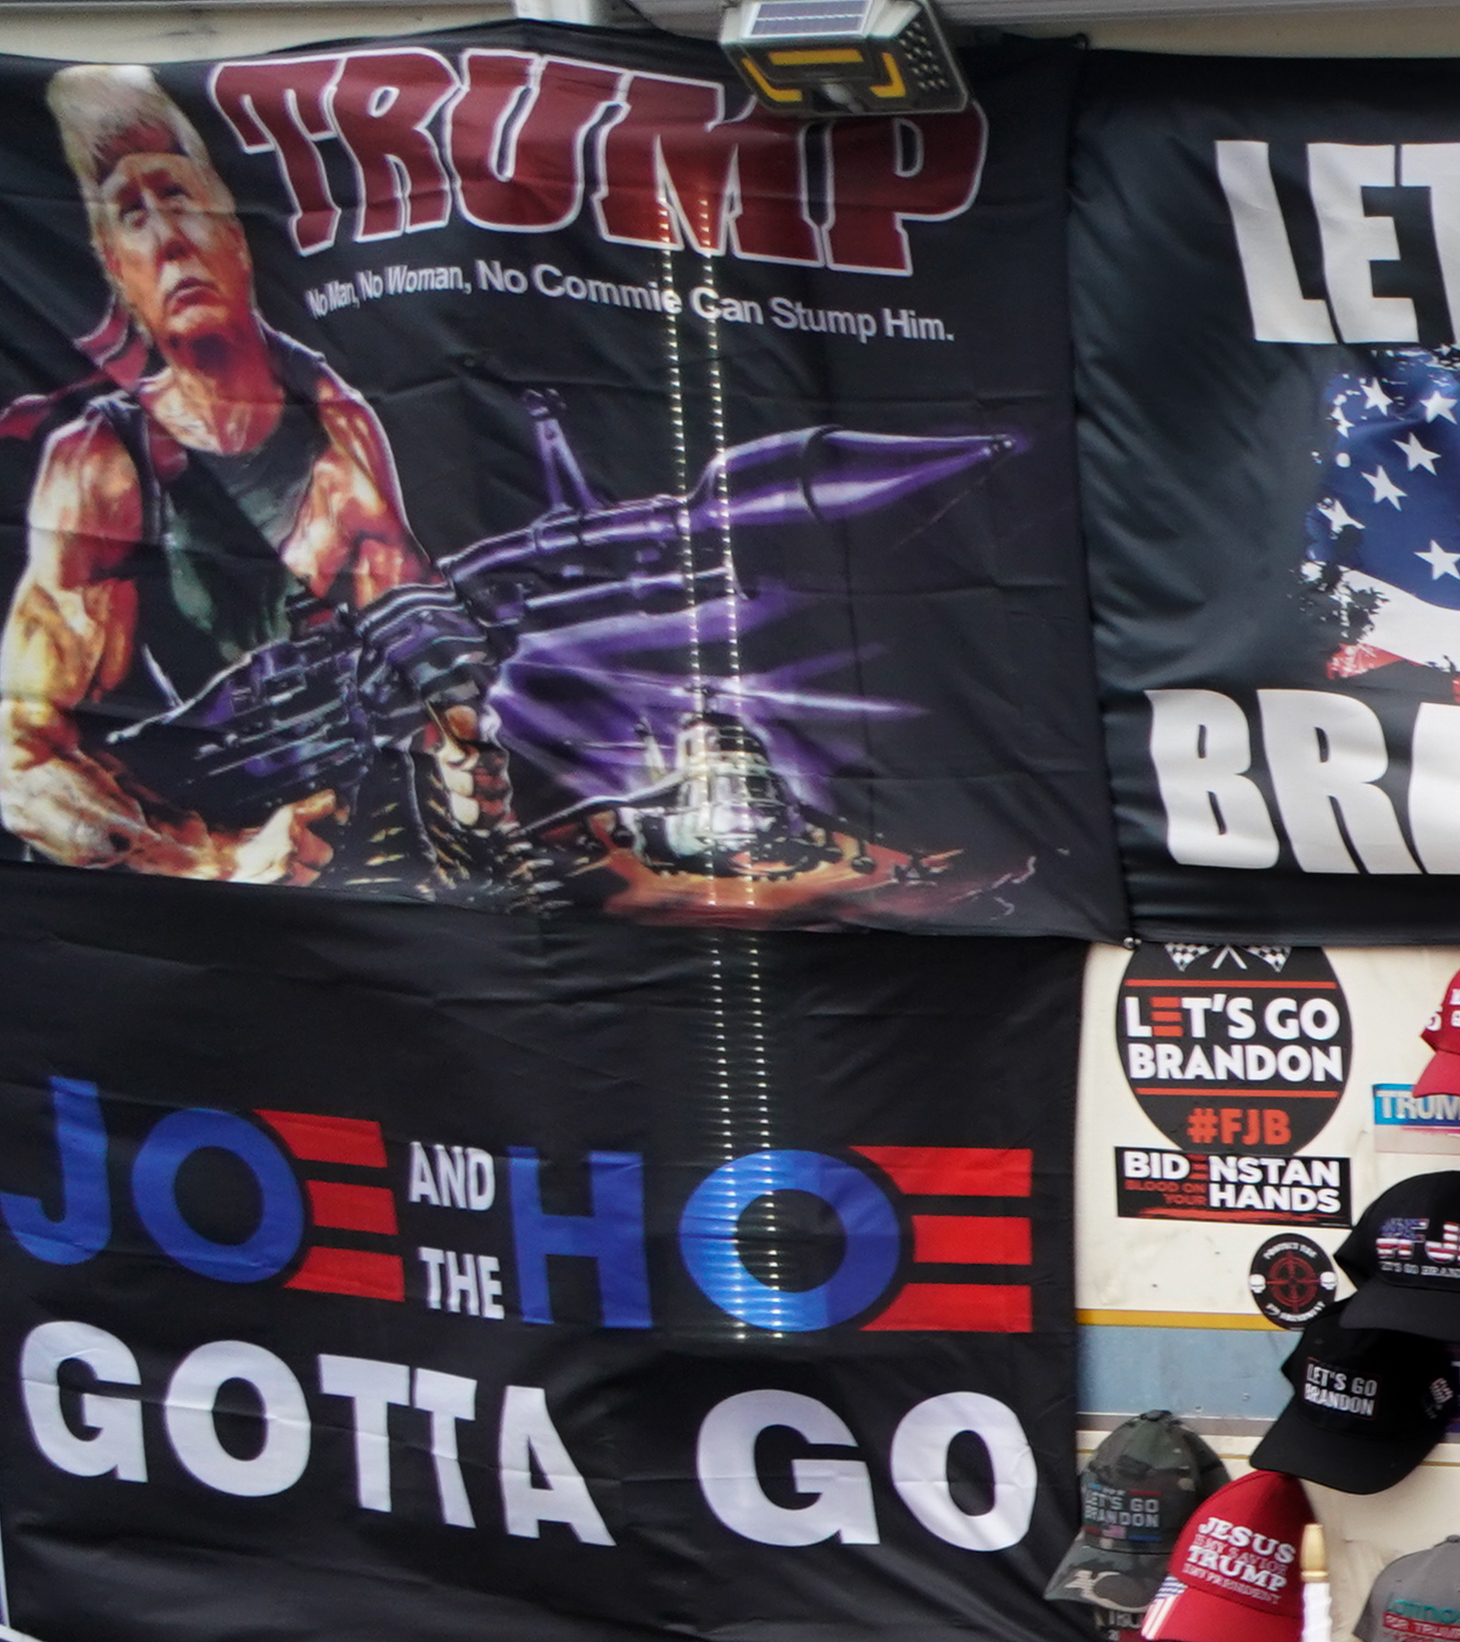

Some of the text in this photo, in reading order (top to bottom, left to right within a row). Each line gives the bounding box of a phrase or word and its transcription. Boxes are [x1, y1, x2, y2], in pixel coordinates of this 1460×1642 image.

[208, 45, 990, 277] TRUMP
[306, 288, 329, 319] No
[360, 270, 384, 298] No
[385, 265, 471, 295] Woman,
[474, 260, 528, 293] No
[534, 265, 682, 313] Commie
[689, 287, 764, 326] Can
[770, 298, 876, 344] Stump
[883, 309, 954, 342] Him.
[1125, 994, 1340, 1040] LET'S GO
[1128, 1043, 1343, 1082] BRANDON
[1187, 1108, 1292, 1145] #FJB
[0, 1076, 1033, 1333] JOE AND THE HOE
[1209, 1183, 1341, 1213] HANDS
[1304, 1383, 1375, 1416] BRANDON
[1306, 1363, 1377, 1397] LET'S GO
[18, 1320, 1039, 1553] GOTTA GO
[1198, 1517, 1296, 1564] JESUS
[1187, 1546, 1287, 1592] TRUMP
